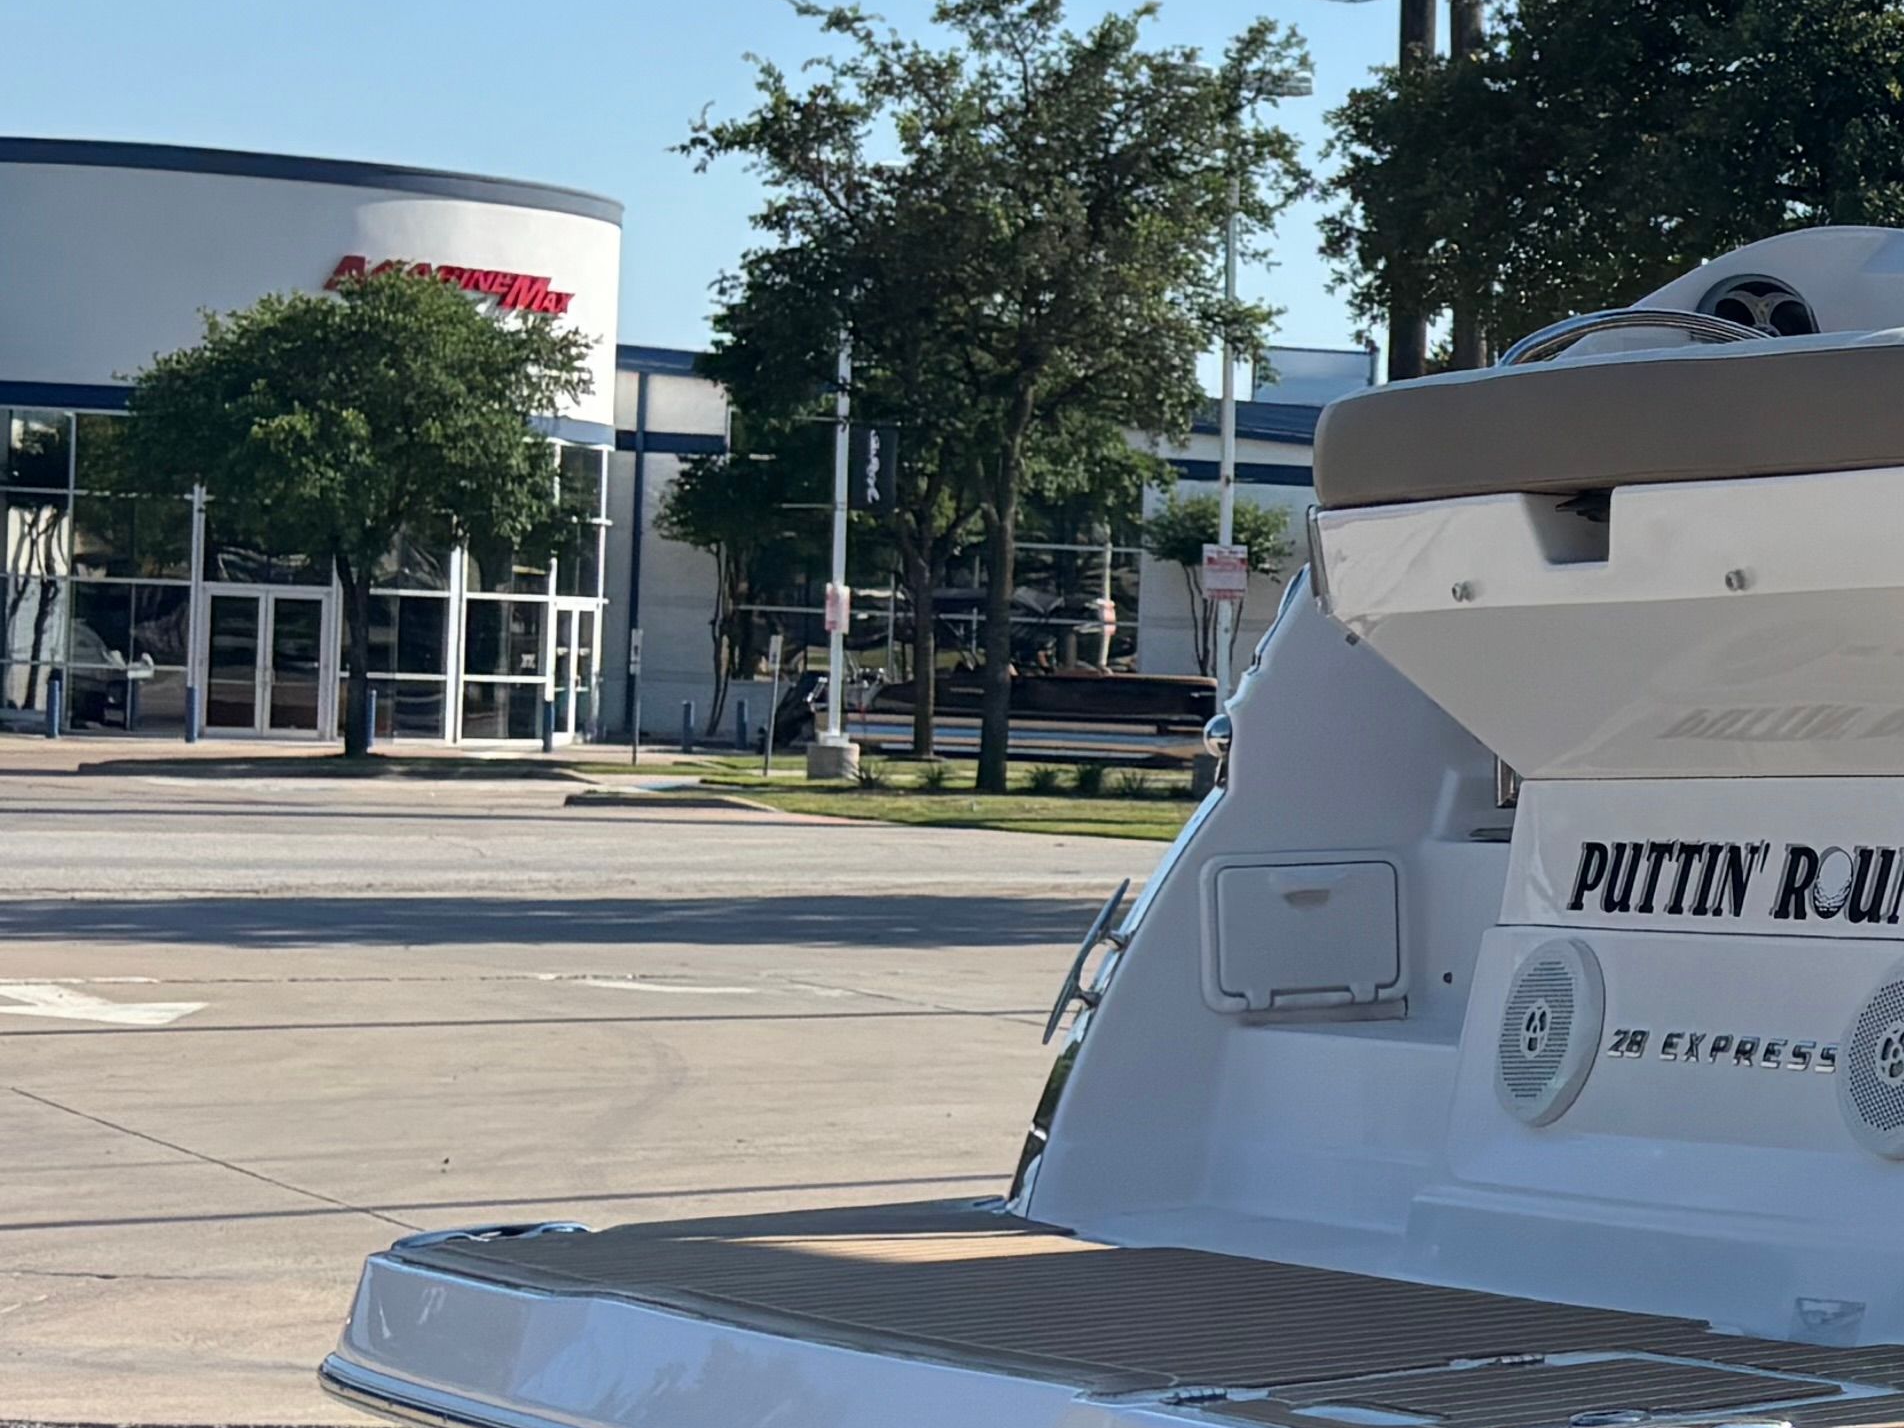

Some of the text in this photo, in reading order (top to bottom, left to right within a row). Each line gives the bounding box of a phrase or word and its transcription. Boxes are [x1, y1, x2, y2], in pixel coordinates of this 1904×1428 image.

[1567, 838, 1770, 918] PUTTIN'
[1606, 1028, 1840, 1074] 28 EXPRESS
